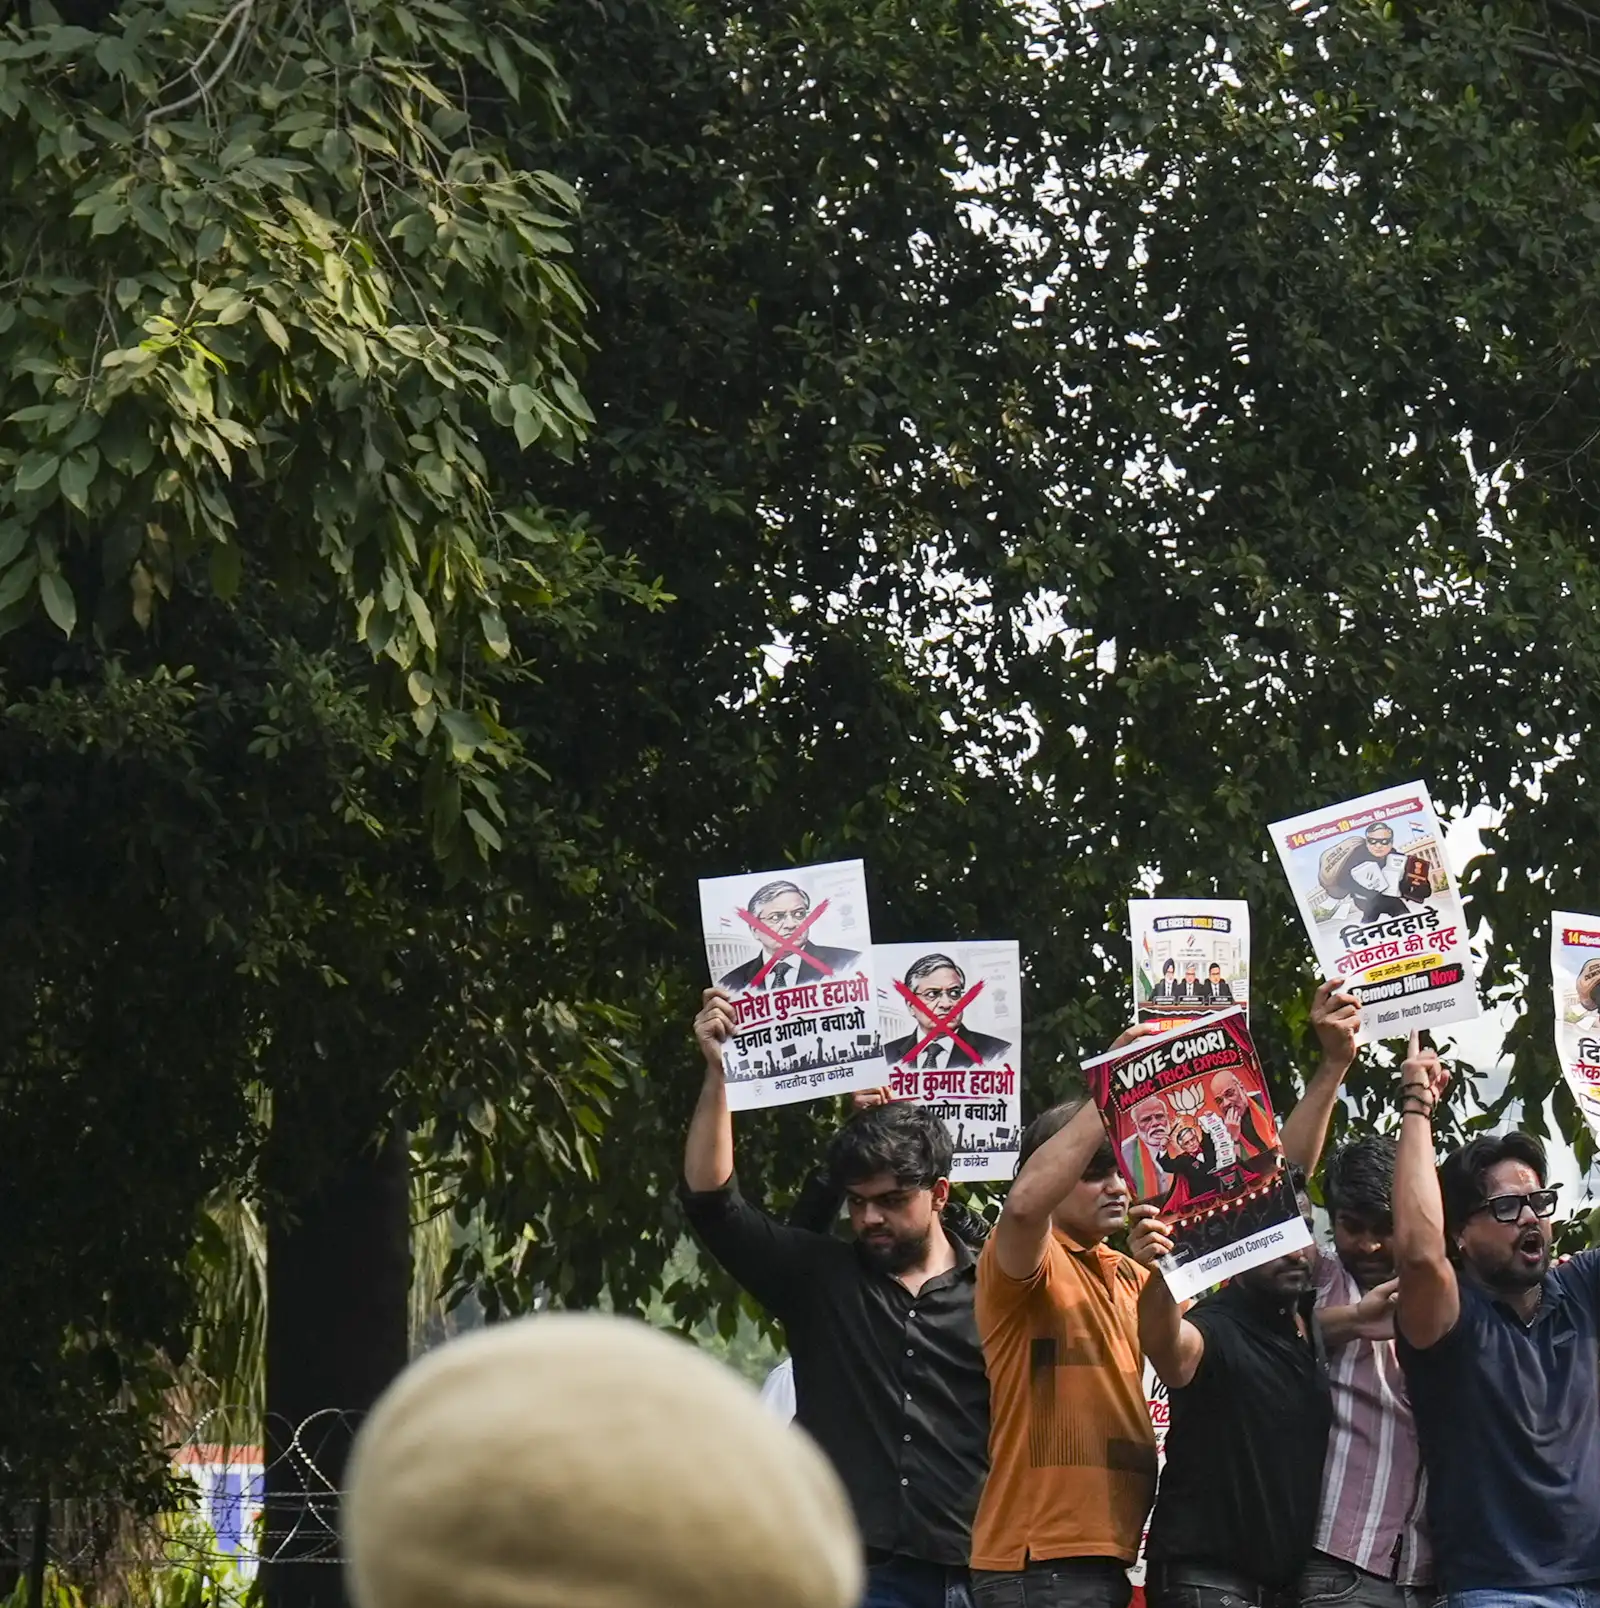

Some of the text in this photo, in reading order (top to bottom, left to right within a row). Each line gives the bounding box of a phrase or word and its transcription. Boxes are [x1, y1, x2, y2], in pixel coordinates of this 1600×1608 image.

[1292, 834, 1305, 847] 14
[1337, 820, 1350, 832] 10
[1339, 905, 1440, 949] दिनदहाड़े
[1568, 932, 1579, 944] 14
[1335, 926, 1458, 974] लोकतंत्र की लूट
[774, 986, 818, 1021] कुमार
[823, 971, 870, 1006] हटाओ
[1354, 969, 1459, 1003] Remove Him Now
[1378, 998, 1456, 1024] Indian Youth Congress
[733, 1006, 866, 1057] चुनाव आयोग बचाओ
[1117, 1029, 1226, 1090] VOTE-CHORI
[775, 1067, 854, 1091] भारतीय युवा कांग्रेस
[889, 1063, 1014, 1100] नेश कुमार हटाओ
[1120, 1049, 1238, 1109] MAGIC TRICK EXPOSED
[964, 1099, 1007, 1122] बचाओ
[963, 1154, 989, 1168] कांग्रेस
[1198, 1229, 1284, 1273] Indian Youth Congress
